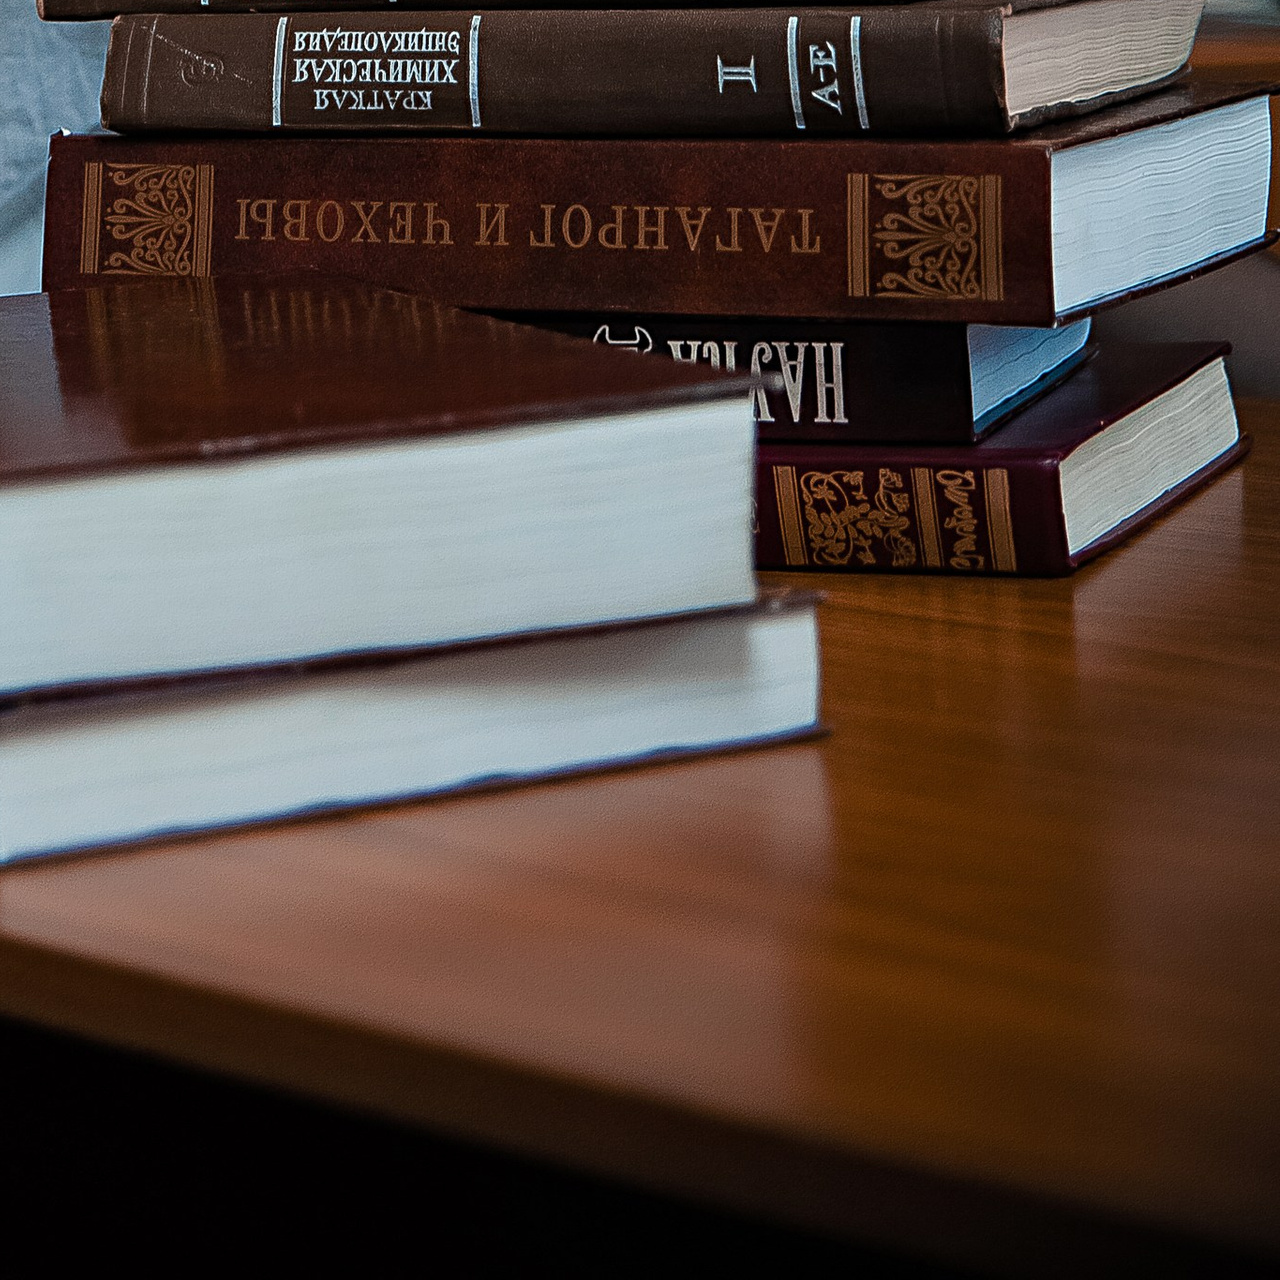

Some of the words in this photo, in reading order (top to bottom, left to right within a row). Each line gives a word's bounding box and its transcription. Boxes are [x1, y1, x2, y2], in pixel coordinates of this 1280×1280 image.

[292, 27, 461, 55] ЭНЦИКЛОПЕДИЯ
[292, 58, 460, 84] ХИМИЧЕСКАЯ
[314, 89, 433, 111] КРАТКАЯ
[234, 198, 455, 246] ЧЕХОВЫ
[475, 203, 510, 247] И
[530, 204, 821, 253] ТАГАНРОГ
